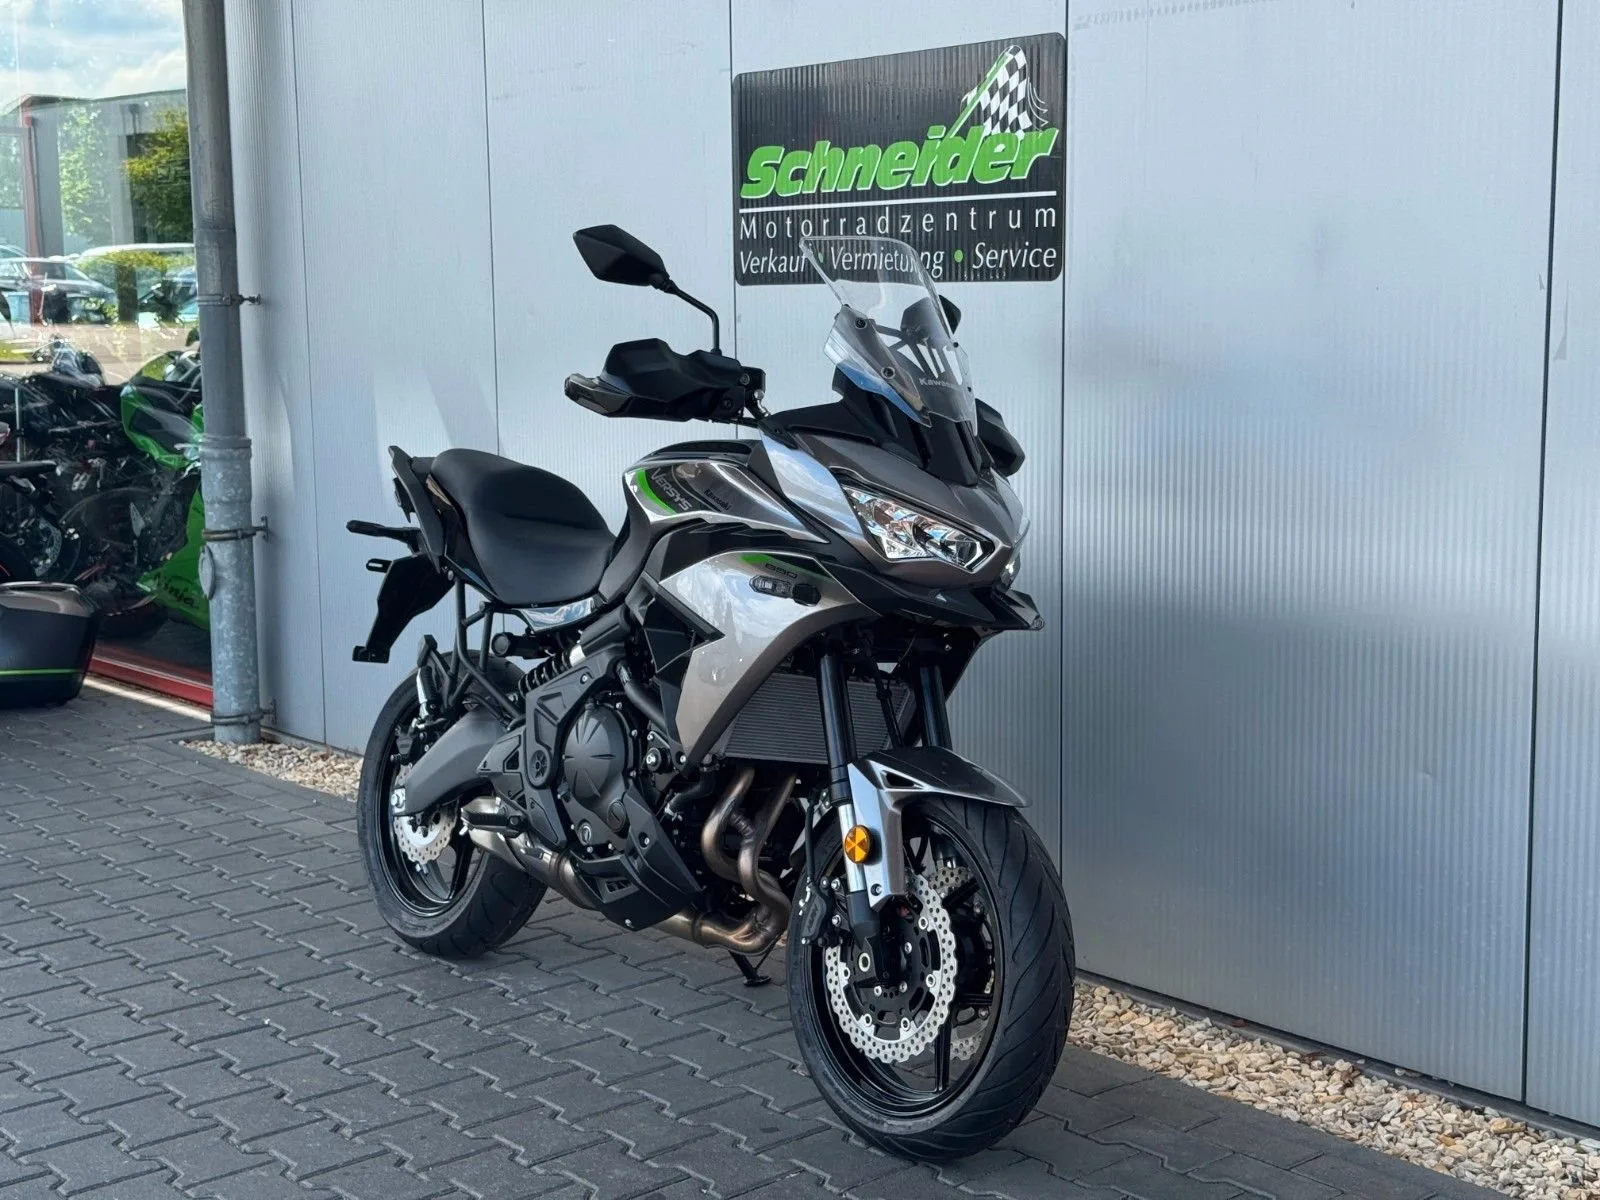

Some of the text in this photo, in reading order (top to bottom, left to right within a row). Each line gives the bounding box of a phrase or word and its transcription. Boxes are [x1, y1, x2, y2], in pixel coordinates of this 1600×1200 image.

[740, 124, 1059, 199] Schneider
[739, 206, 1056, 240] Motorradzentrum
[830, 246, 945, 279] Vermietung
[972, 241, 1057, 269] Service
[651, 467, 693, 511] VERSYS
